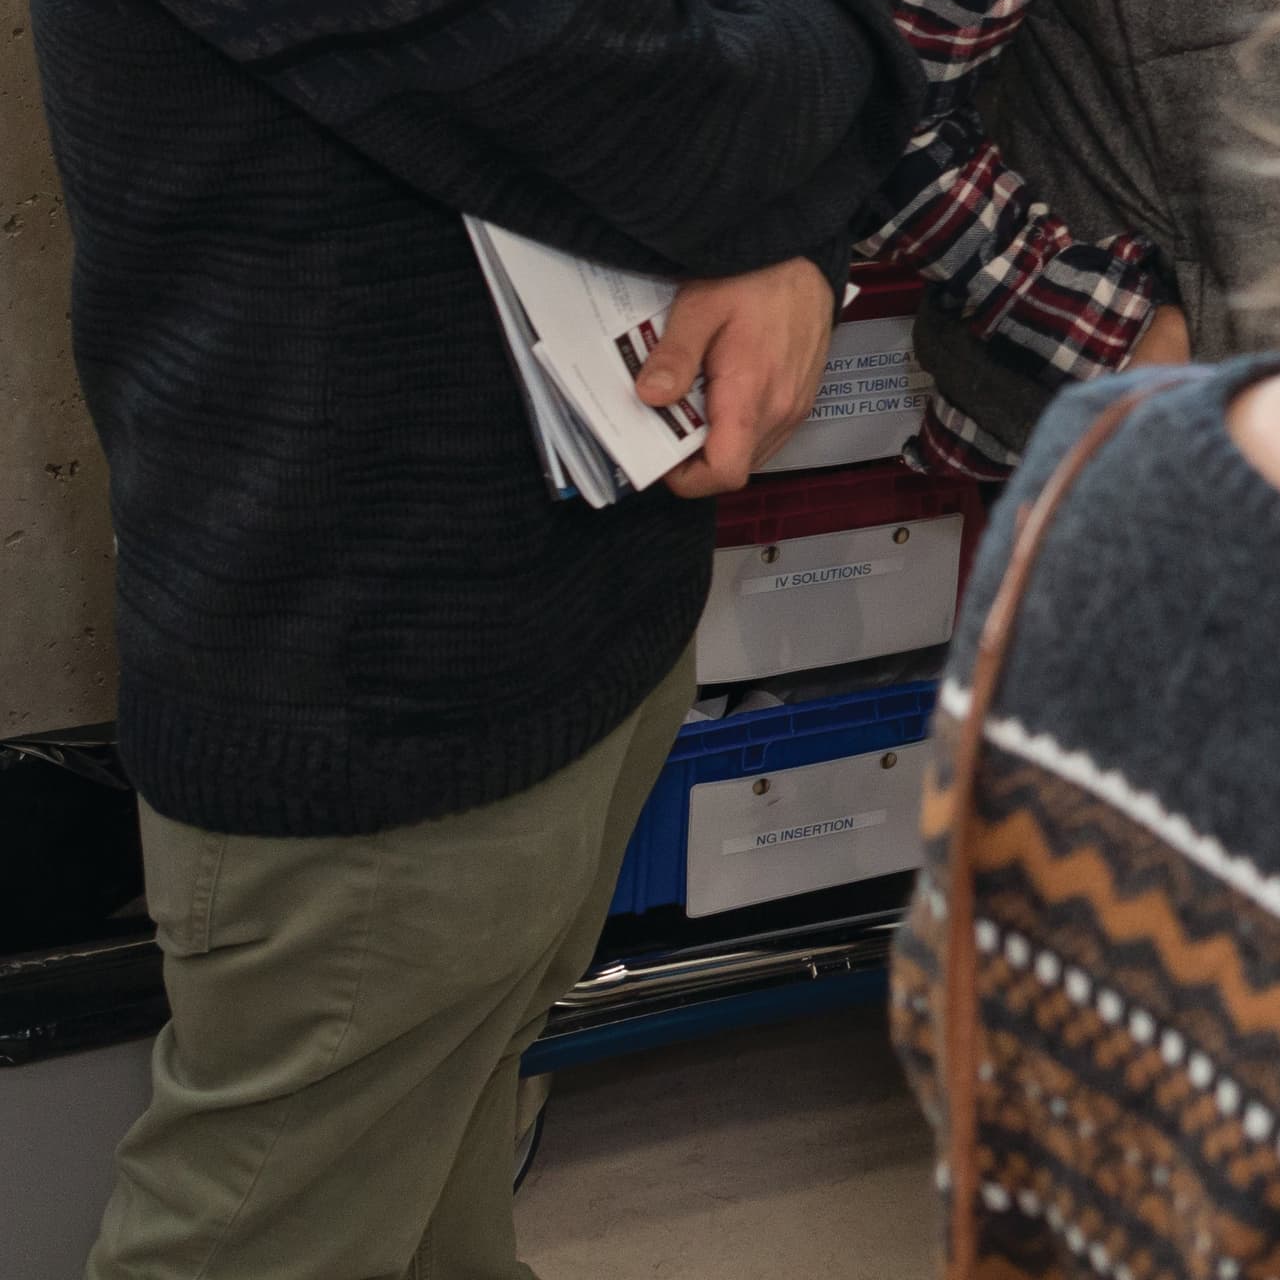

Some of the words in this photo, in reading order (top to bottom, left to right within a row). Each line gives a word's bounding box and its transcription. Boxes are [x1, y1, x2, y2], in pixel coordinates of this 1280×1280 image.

[857, 375, 910, 392] TUBING
[858, 398, 900, 413] FLOW
[775, 575, 789, 589] IV
[791, 563, 873, 586] SOLUTIONS
[756, 832, 777, 846] NG
[780, 817, 855, 841] INSERTION
